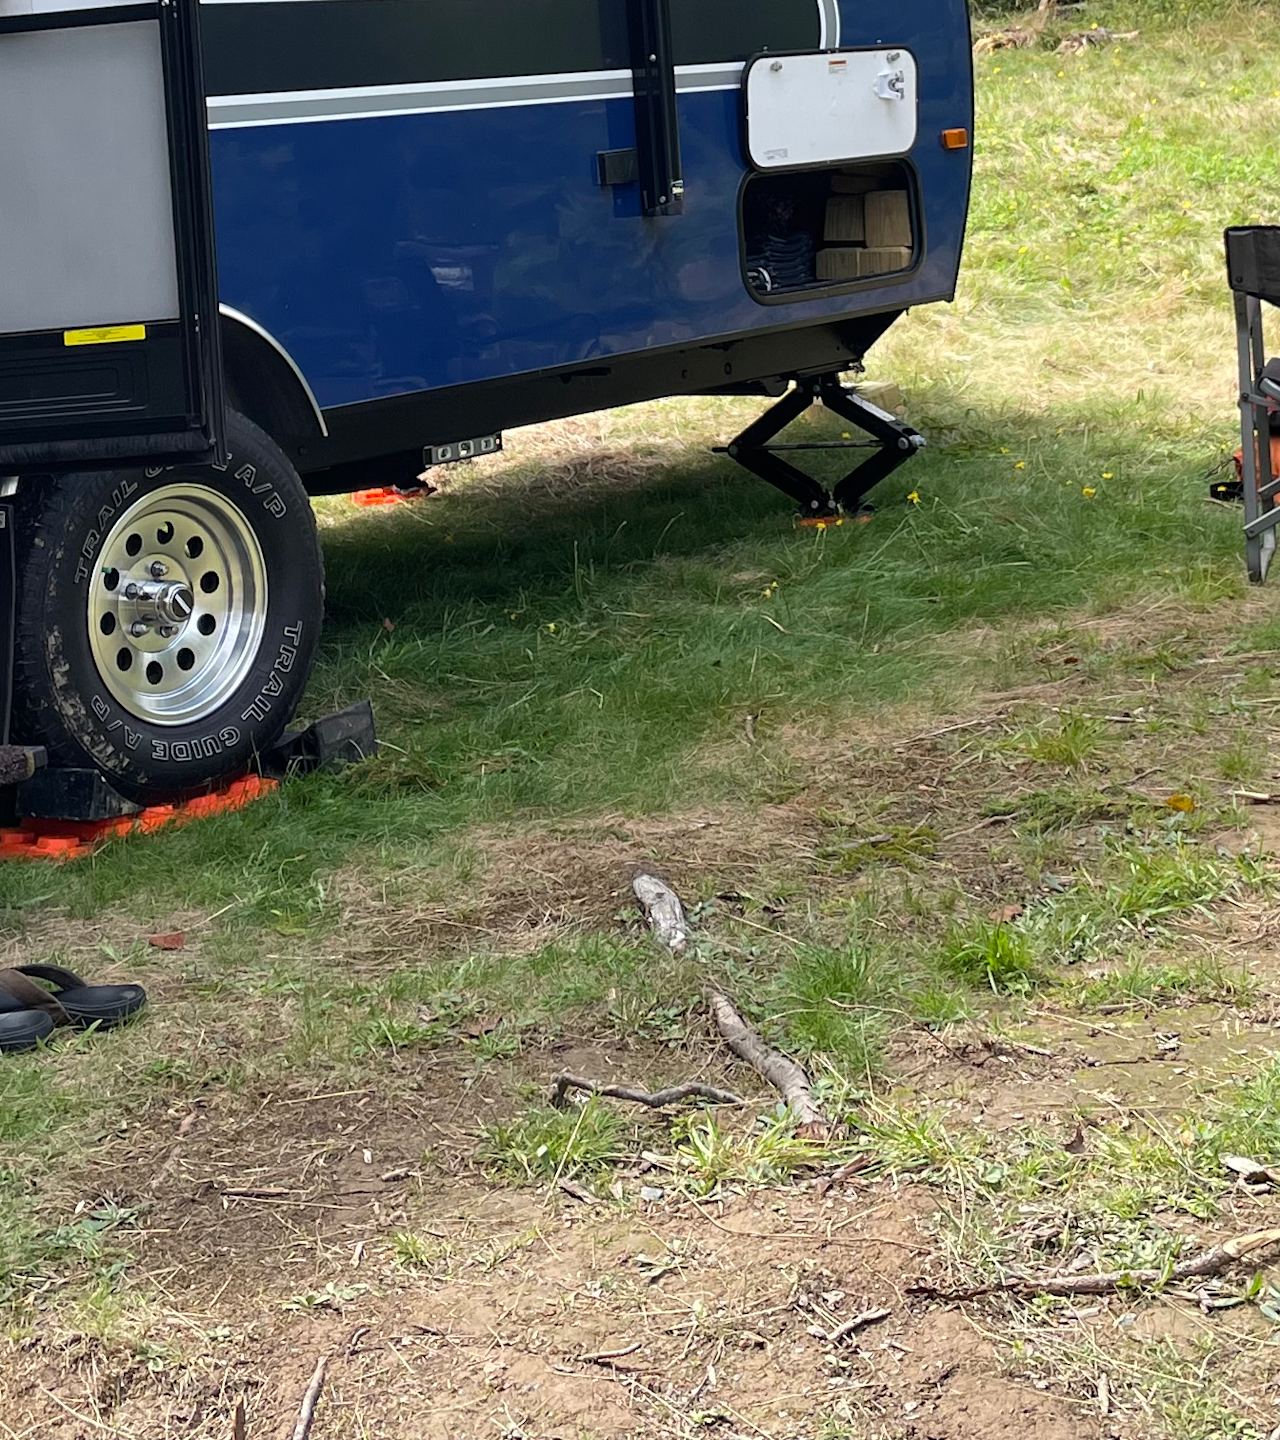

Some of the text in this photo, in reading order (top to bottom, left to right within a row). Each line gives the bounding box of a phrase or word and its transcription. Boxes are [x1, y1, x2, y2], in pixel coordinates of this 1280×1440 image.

[74, 479, 139, 585] TRAIL
[240, 620, 303, 723] TRAIL
[151, 725, 241, 762] GUIDE
